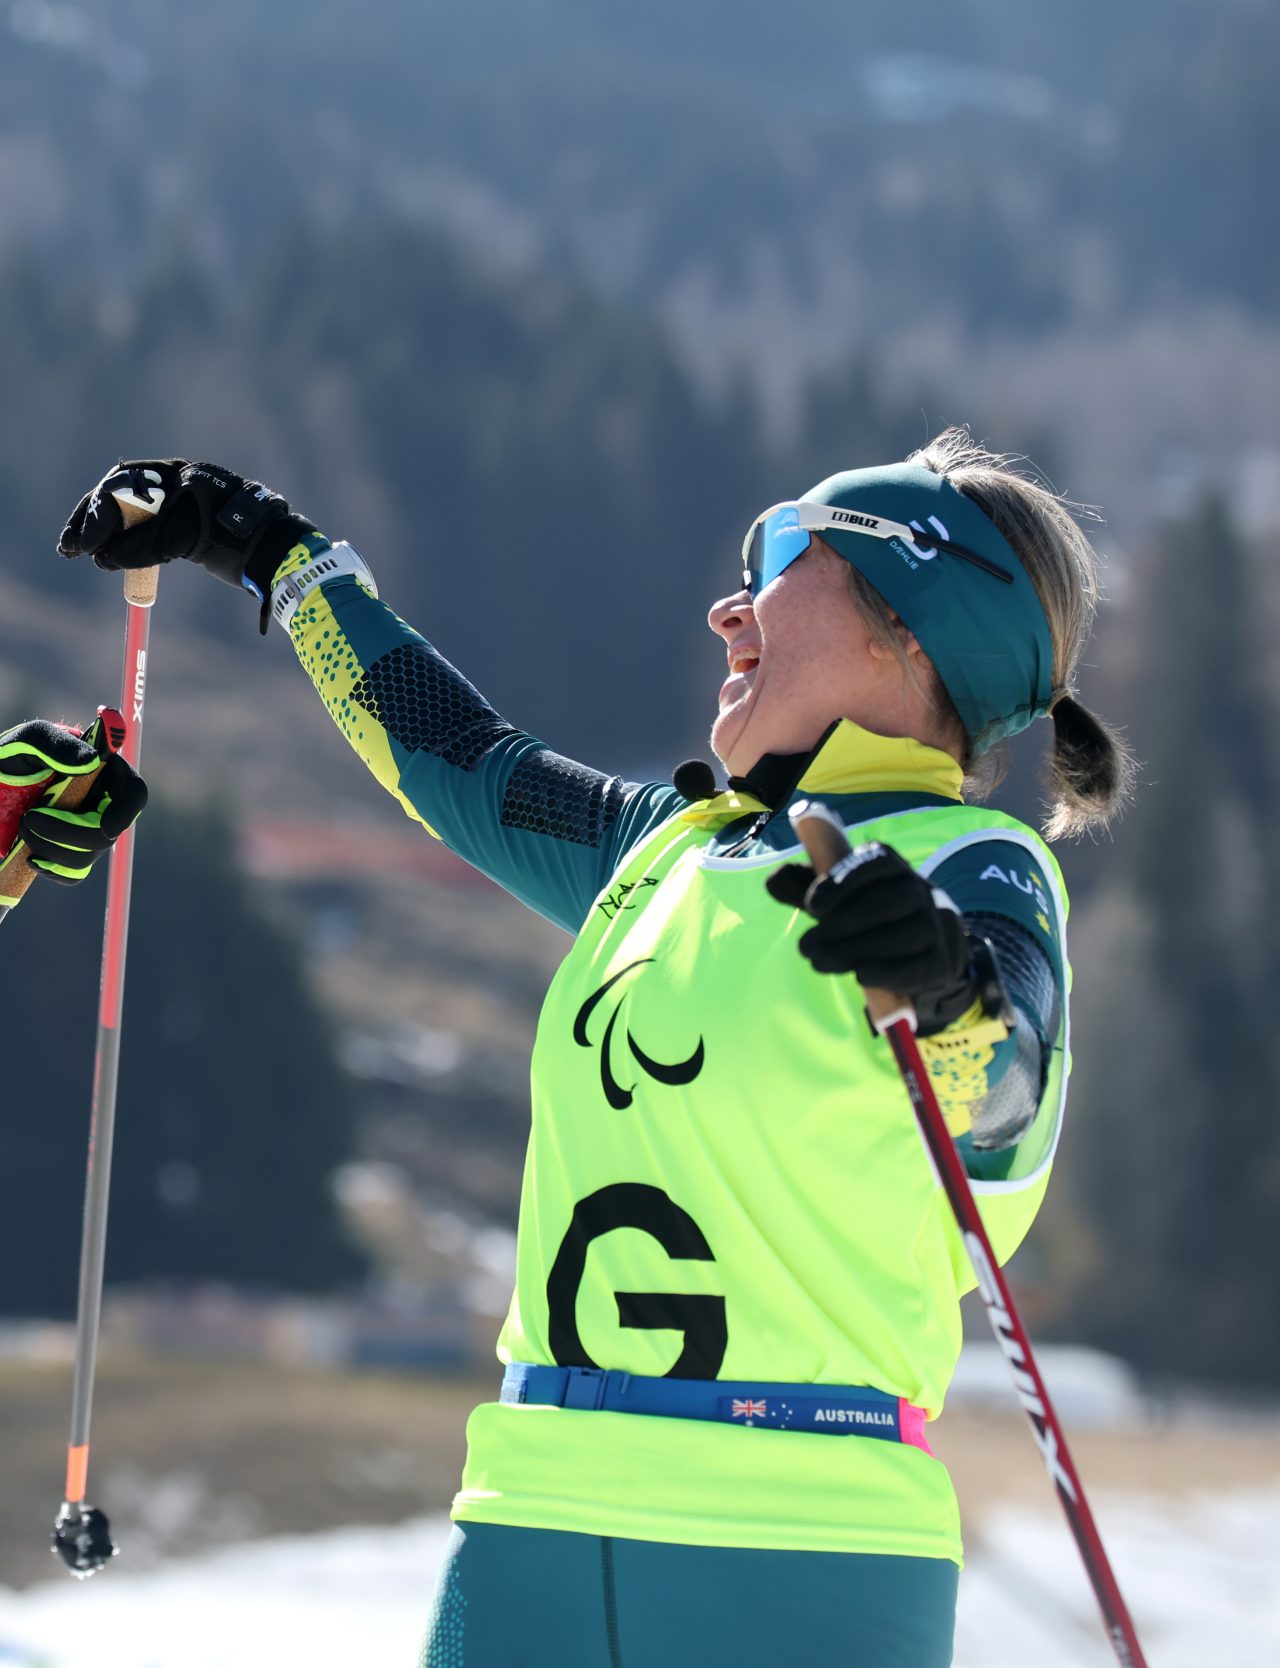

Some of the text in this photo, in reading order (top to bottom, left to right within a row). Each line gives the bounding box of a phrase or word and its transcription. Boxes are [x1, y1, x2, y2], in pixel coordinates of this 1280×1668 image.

[232, 513, 244, 522] R
[848, 514, 879, 529] BLIZ
[132, 649, 146, 724] SWIX
[979, 864, 1049, 915] AUS
[546, 1182, 728, 1380] G
[814, 1408, 895, 1426] AUSTRALIA
